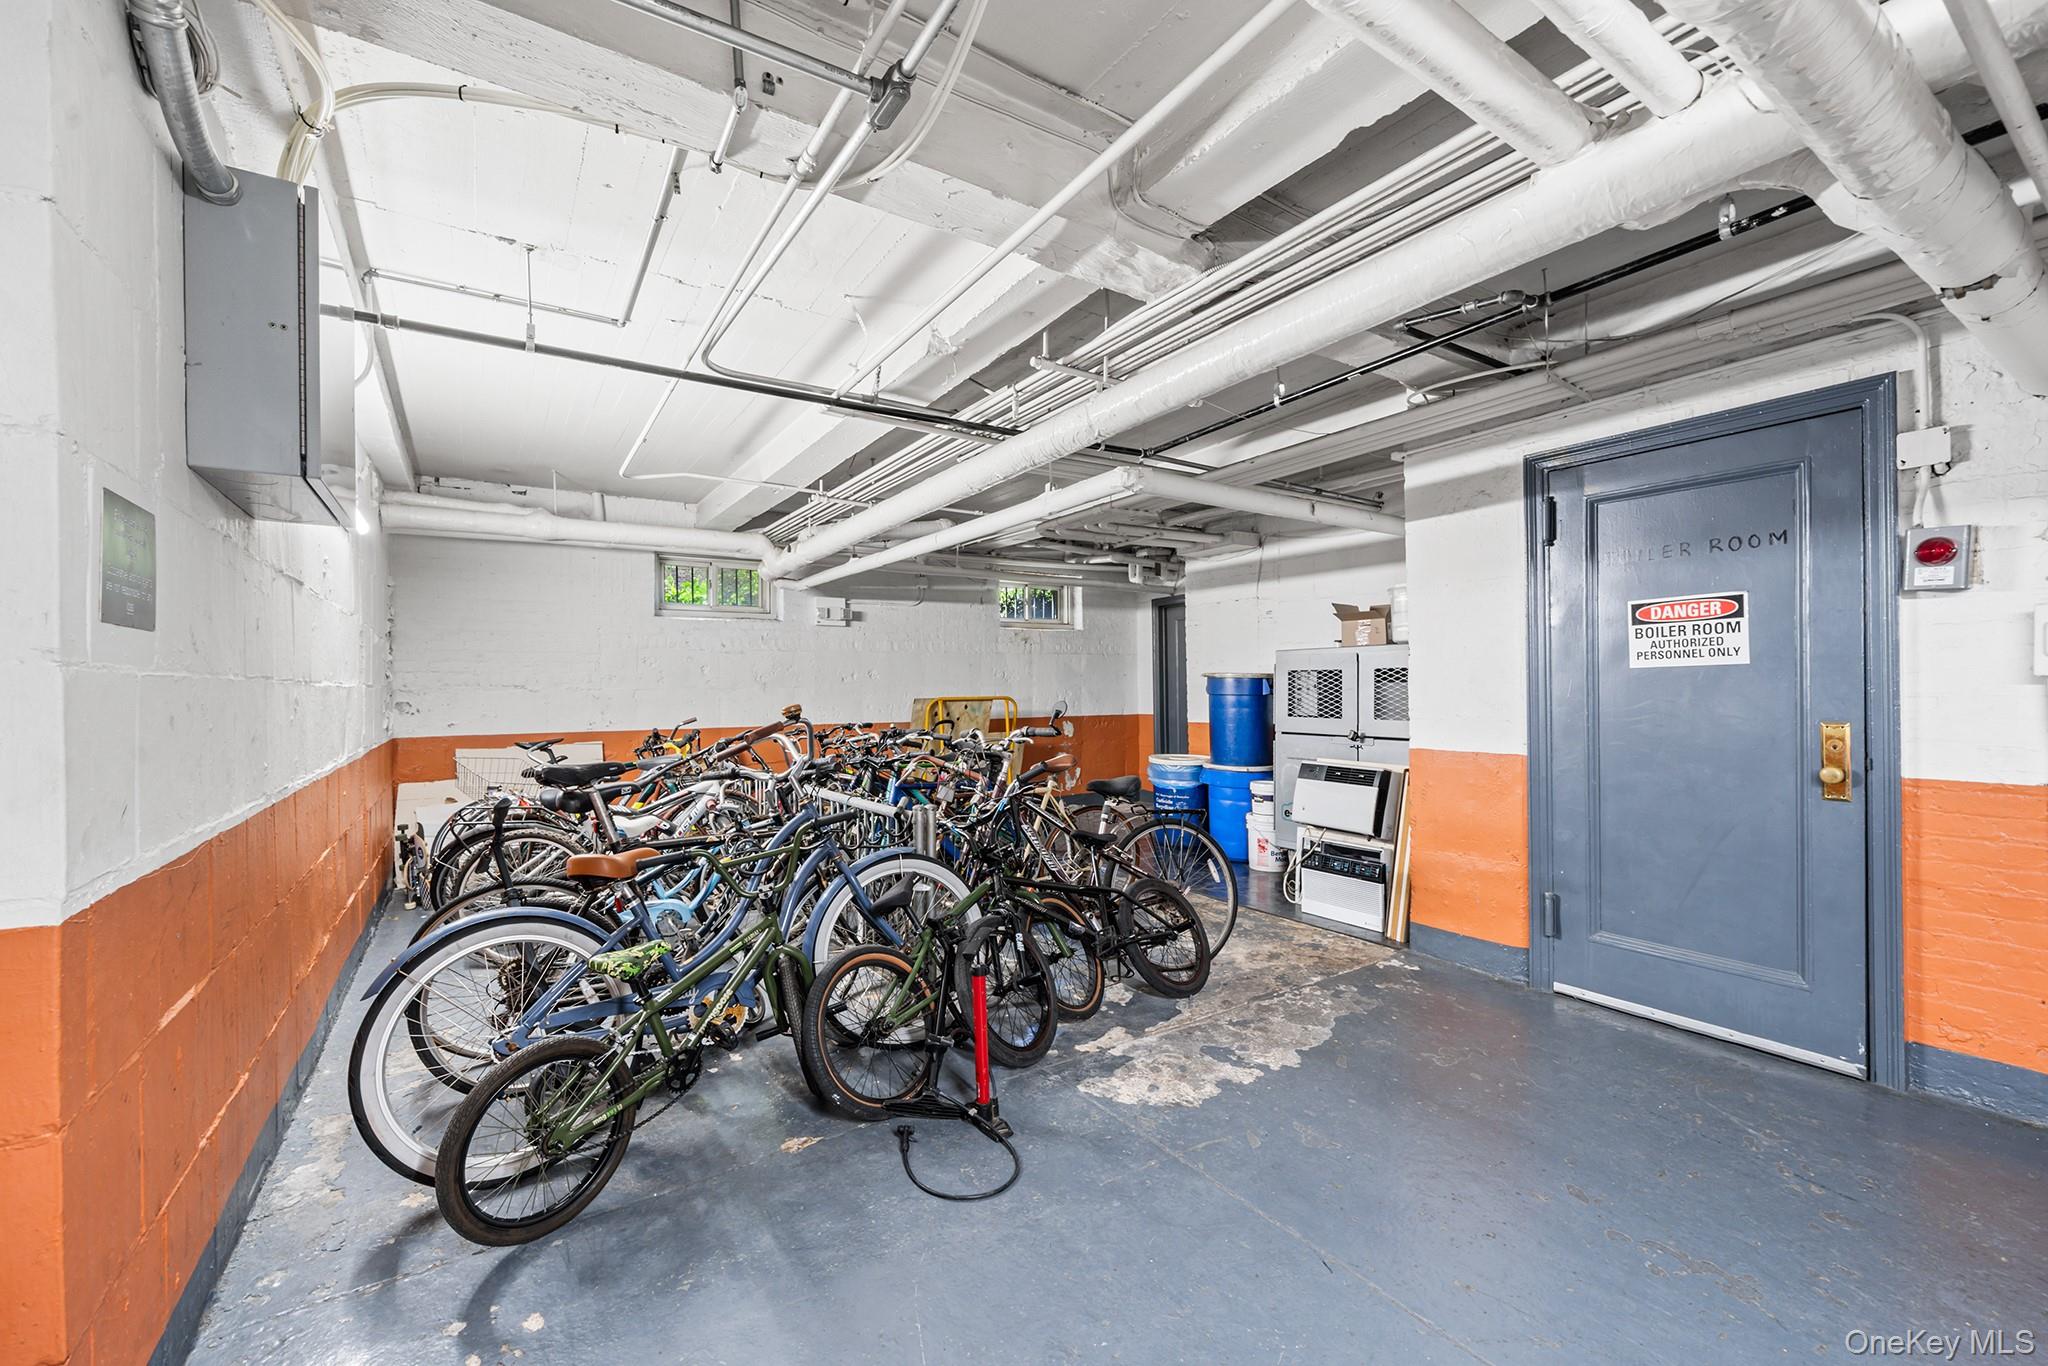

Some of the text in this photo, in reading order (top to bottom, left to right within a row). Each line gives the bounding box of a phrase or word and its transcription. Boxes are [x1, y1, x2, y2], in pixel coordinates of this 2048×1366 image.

[1605, 529, 1788, 567] ILER ROOM
[1650, 601, 1721, 620] DANGER
[1635, 621, 1741, 639] BOILER ROOM
[1650, 636, 1724, 649] AUTHORIZED
[1636, 647, 1741, 661] PERSONNEL ONLY
